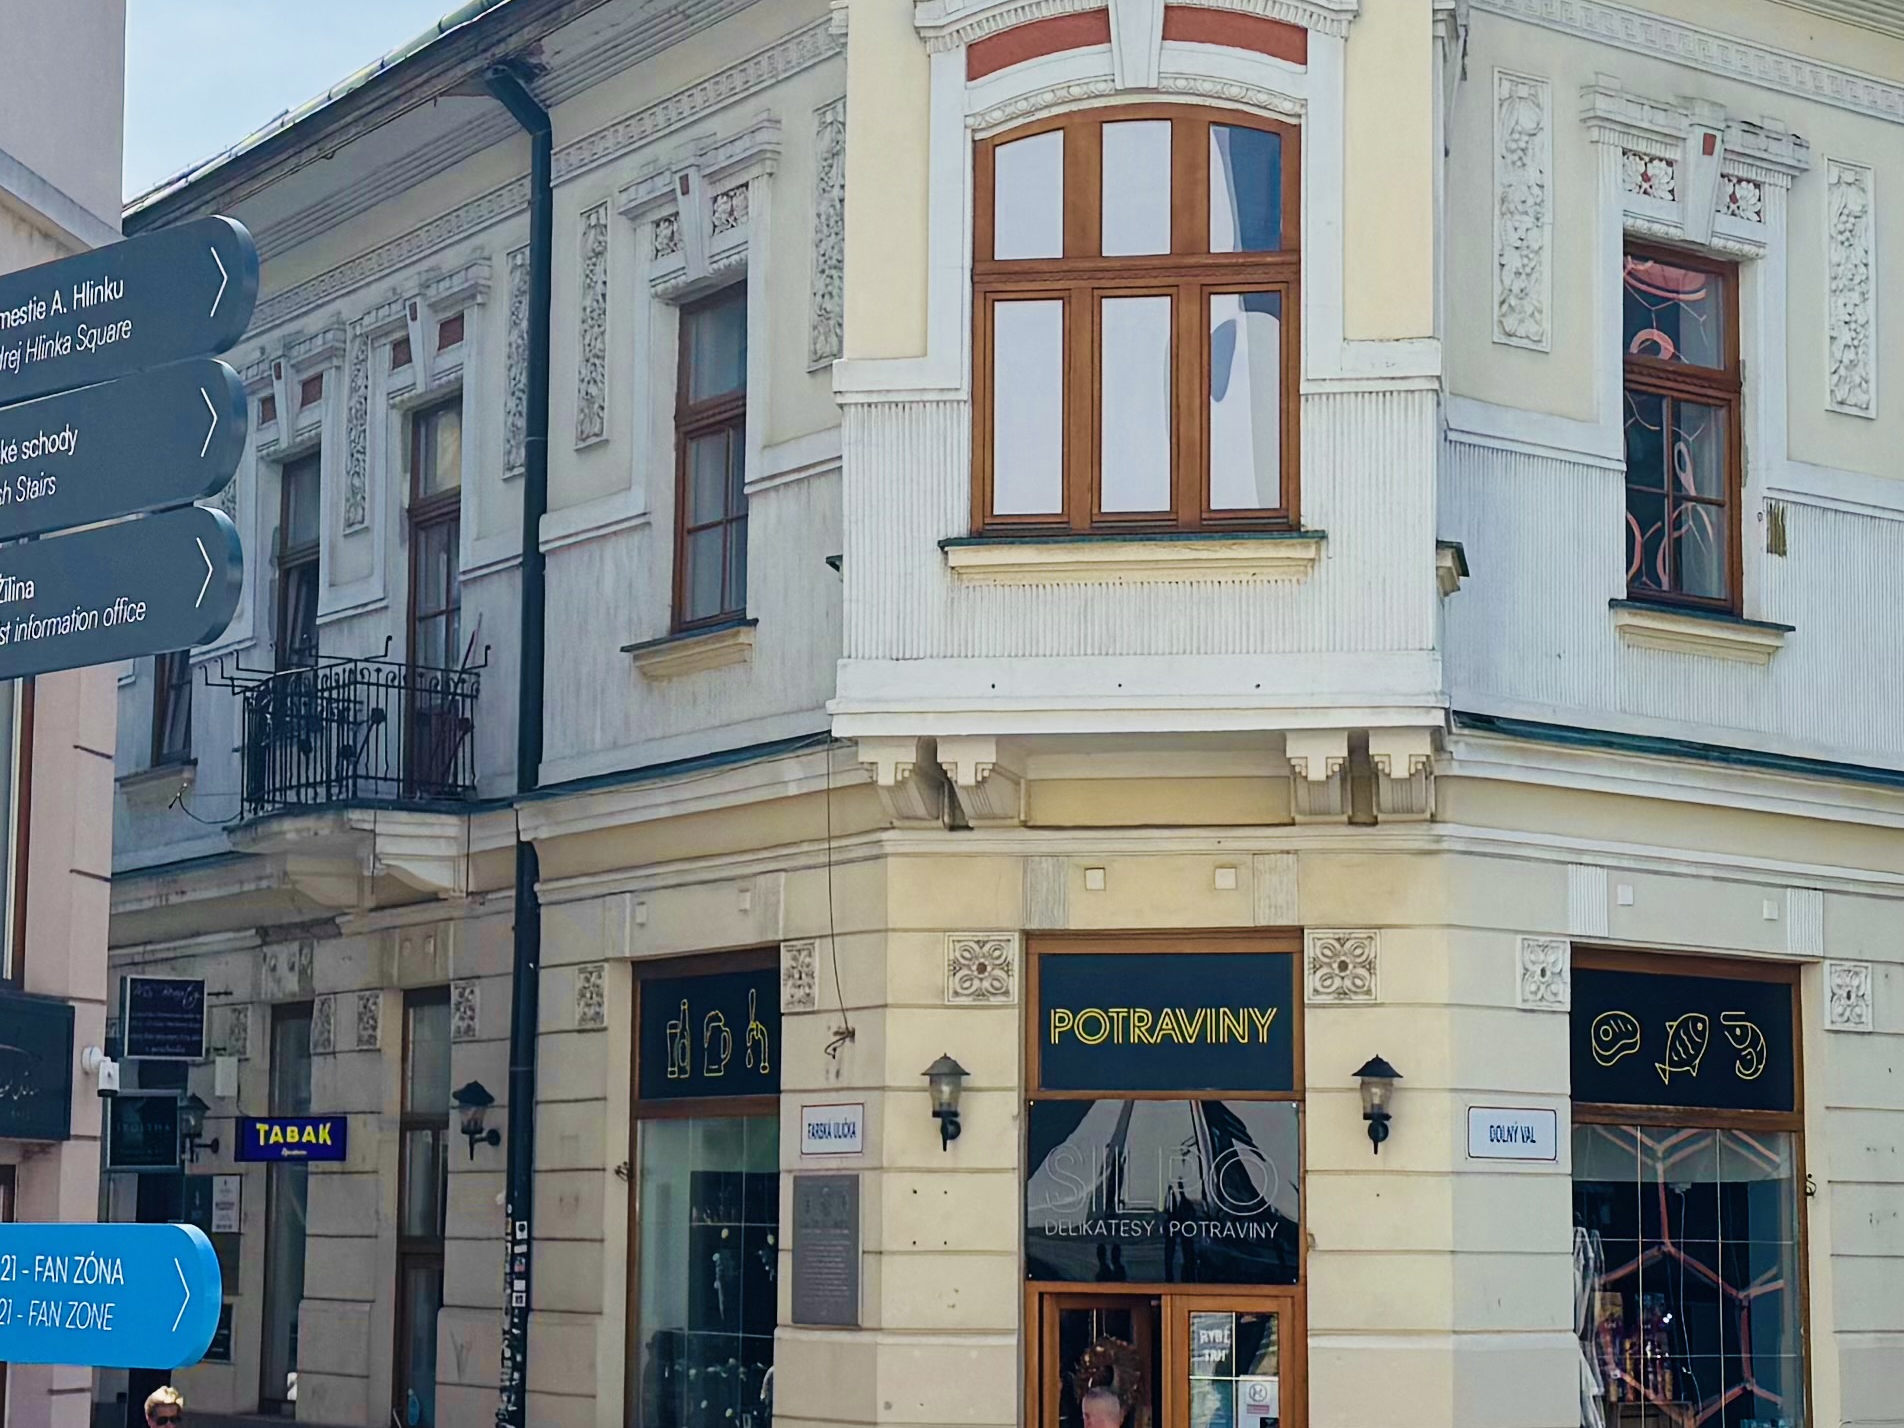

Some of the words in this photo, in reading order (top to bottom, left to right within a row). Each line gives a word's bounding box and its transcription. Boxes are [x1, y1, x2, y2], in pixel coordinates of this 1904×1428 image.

[50, 289, 67, 317] A.
[73, 275, 124, 311] Hlinku
[25, 331, 72, 364] Hlinka
[76, 319, 132, 354] Square
[21, 423, 78, 456] schody
[15, 471, 56, 503] Stairs
[14, 605, 98, 643] information
[103, 596, 146, 627] office
[1050, 1007, 1277, 1045] POTRAVINY
[256, 1122, 332, 1146] TABAK
[1489, 1120, 1518, 1144] DOLNÝ
[1520, 1125, 1536, 1144] VAL
[1046, 1144, 1278, 1215] SILPO
[1045, 1220, 1155, 1237] DELIKATESY
[1169, 1221, 1278, 1239] POTRAVINY
[0, 1254, 17, 1283] 21
[34, 1256, 68, 1284] FAN
[73, 1250, 124, 1286] ZÓNA
[28, 1299, 62, 1328] FAN
[65, 1301, 115, 1331] ZONE
